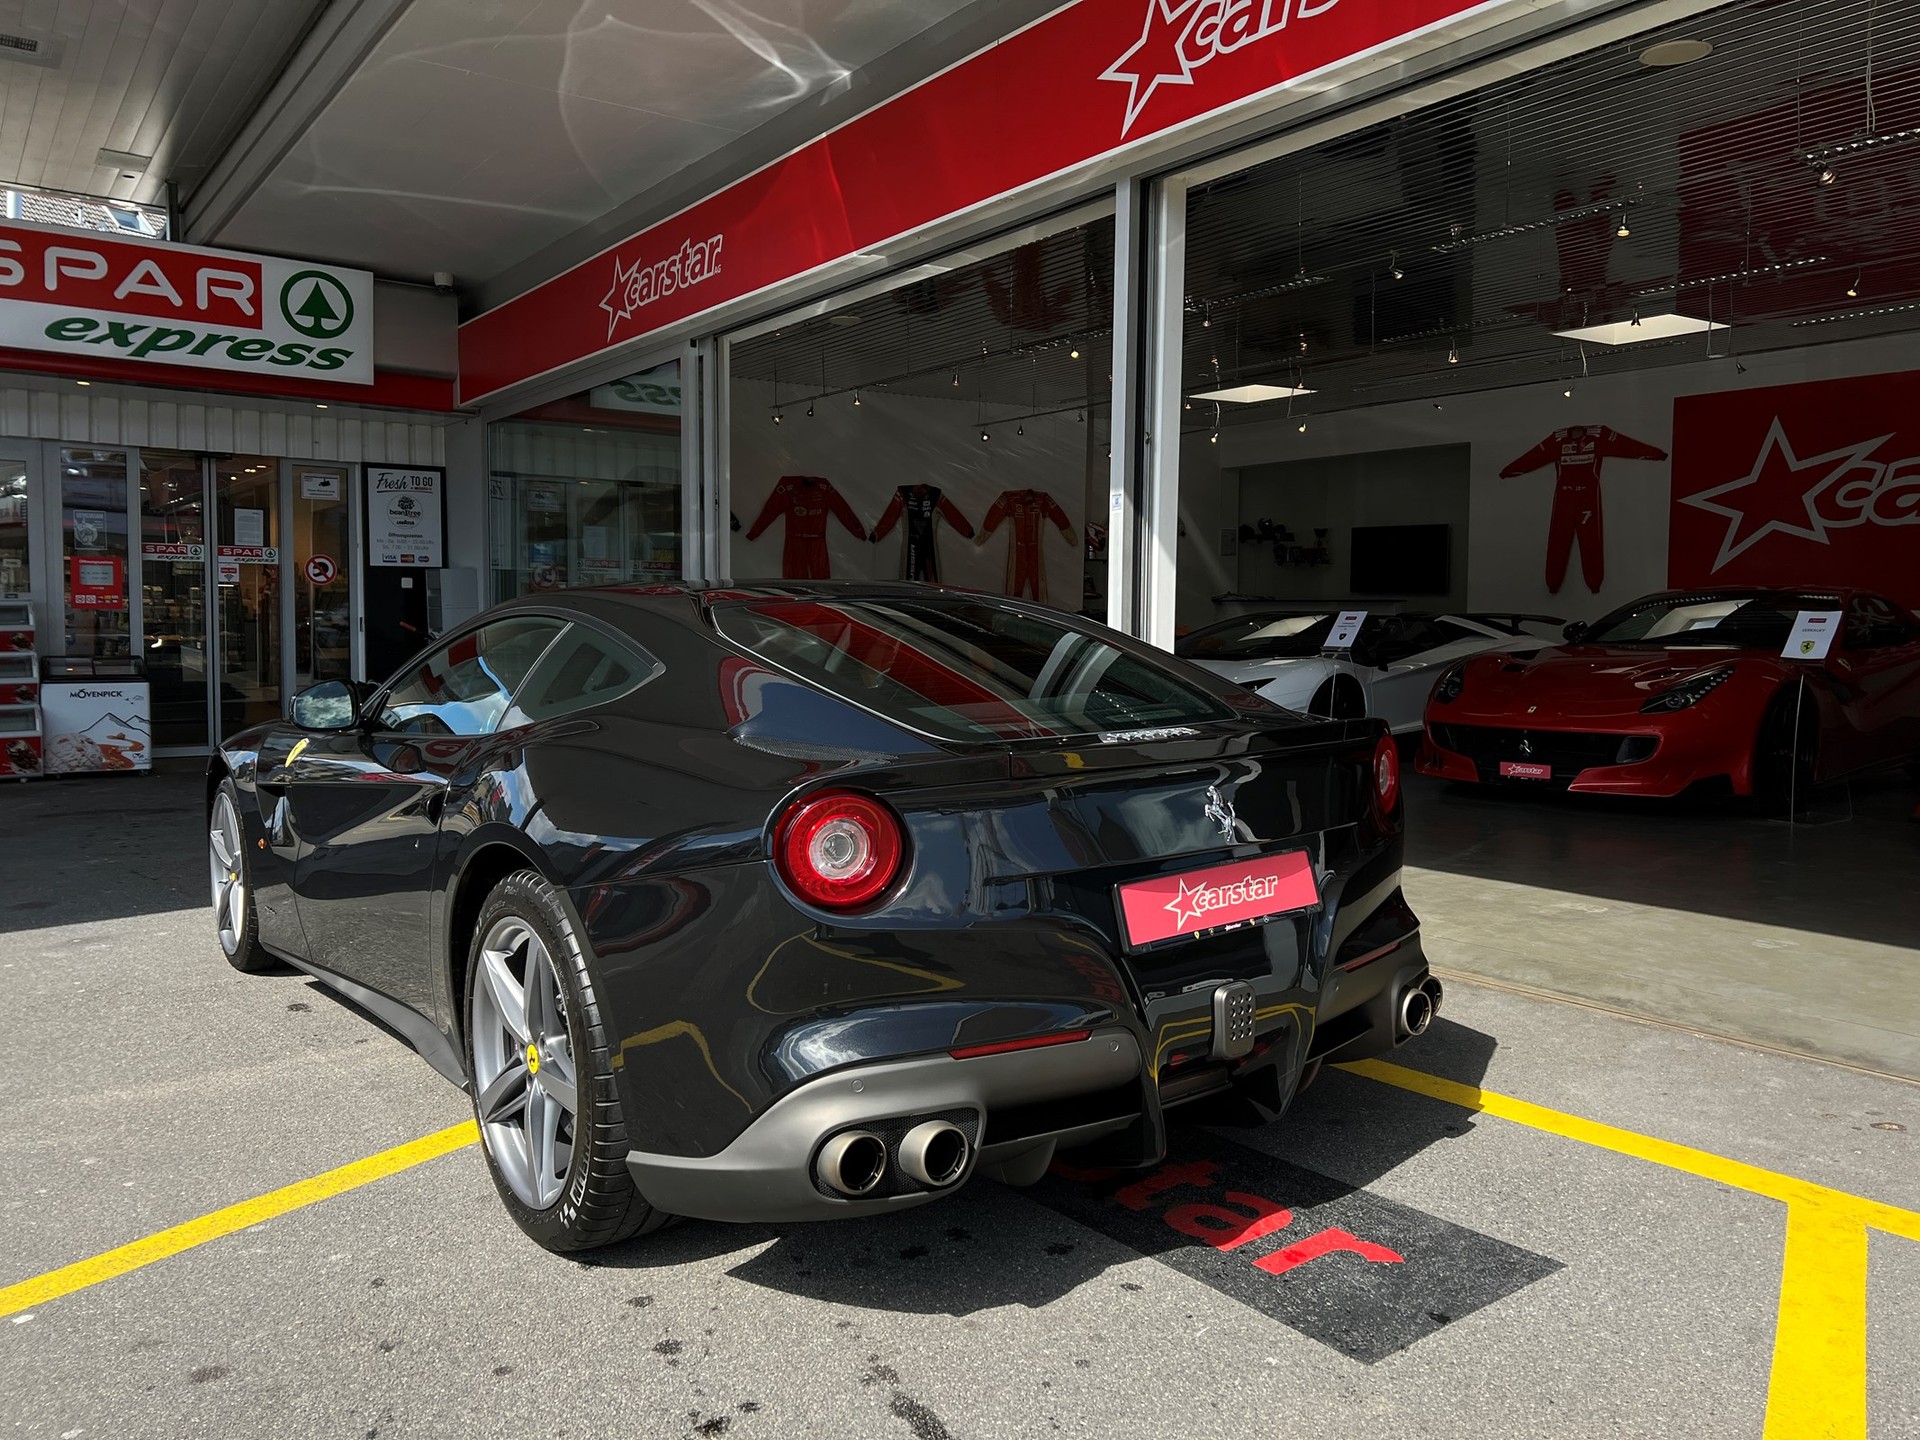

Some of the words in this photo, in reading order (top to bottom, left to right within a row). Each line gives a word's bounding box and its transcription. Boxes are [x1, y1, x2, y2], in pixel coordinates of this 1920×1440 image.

[625, 233, 724, 311] carstar
[713, 264, 722, 275] AG
[44, 317, 355, 371] express
[376, 472, 408, 490] Fresh
[410, 476, 420, 486] TO
[422, 476, 433, 487] GO
[1581, 511, 1592, 525] 7
[145, 545, 188, 554] SPAR
[222, 548, 263, 557] SPAR
[1196, 873, 1278, 914] carstar
